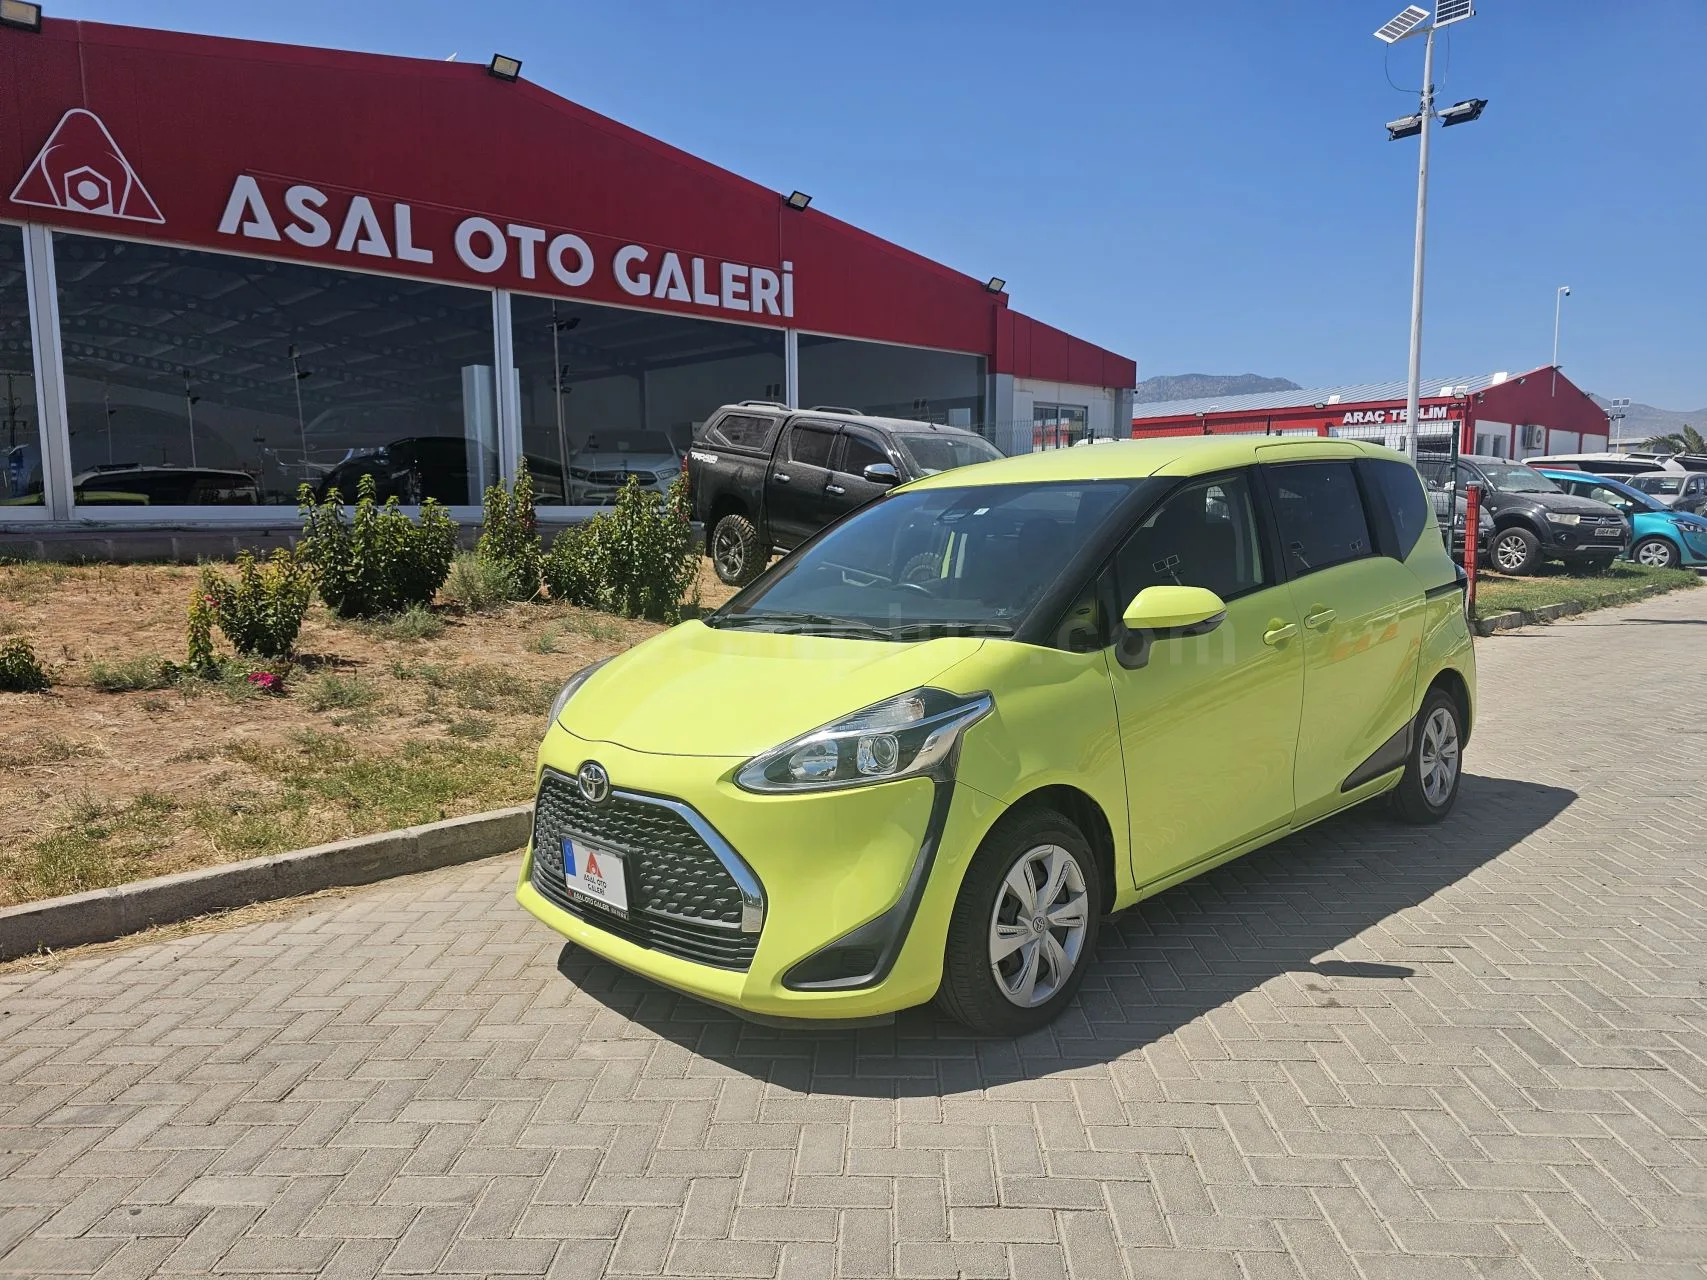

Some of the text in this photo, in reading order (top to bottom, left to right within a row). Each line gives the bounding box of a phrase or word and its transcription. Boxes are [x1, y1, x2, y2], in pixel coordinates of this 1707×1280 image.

[218, 174, 795, 318] ASAL OTO GALERİ
[1343, 405, 1448, 424] ARAÇ TELİM
